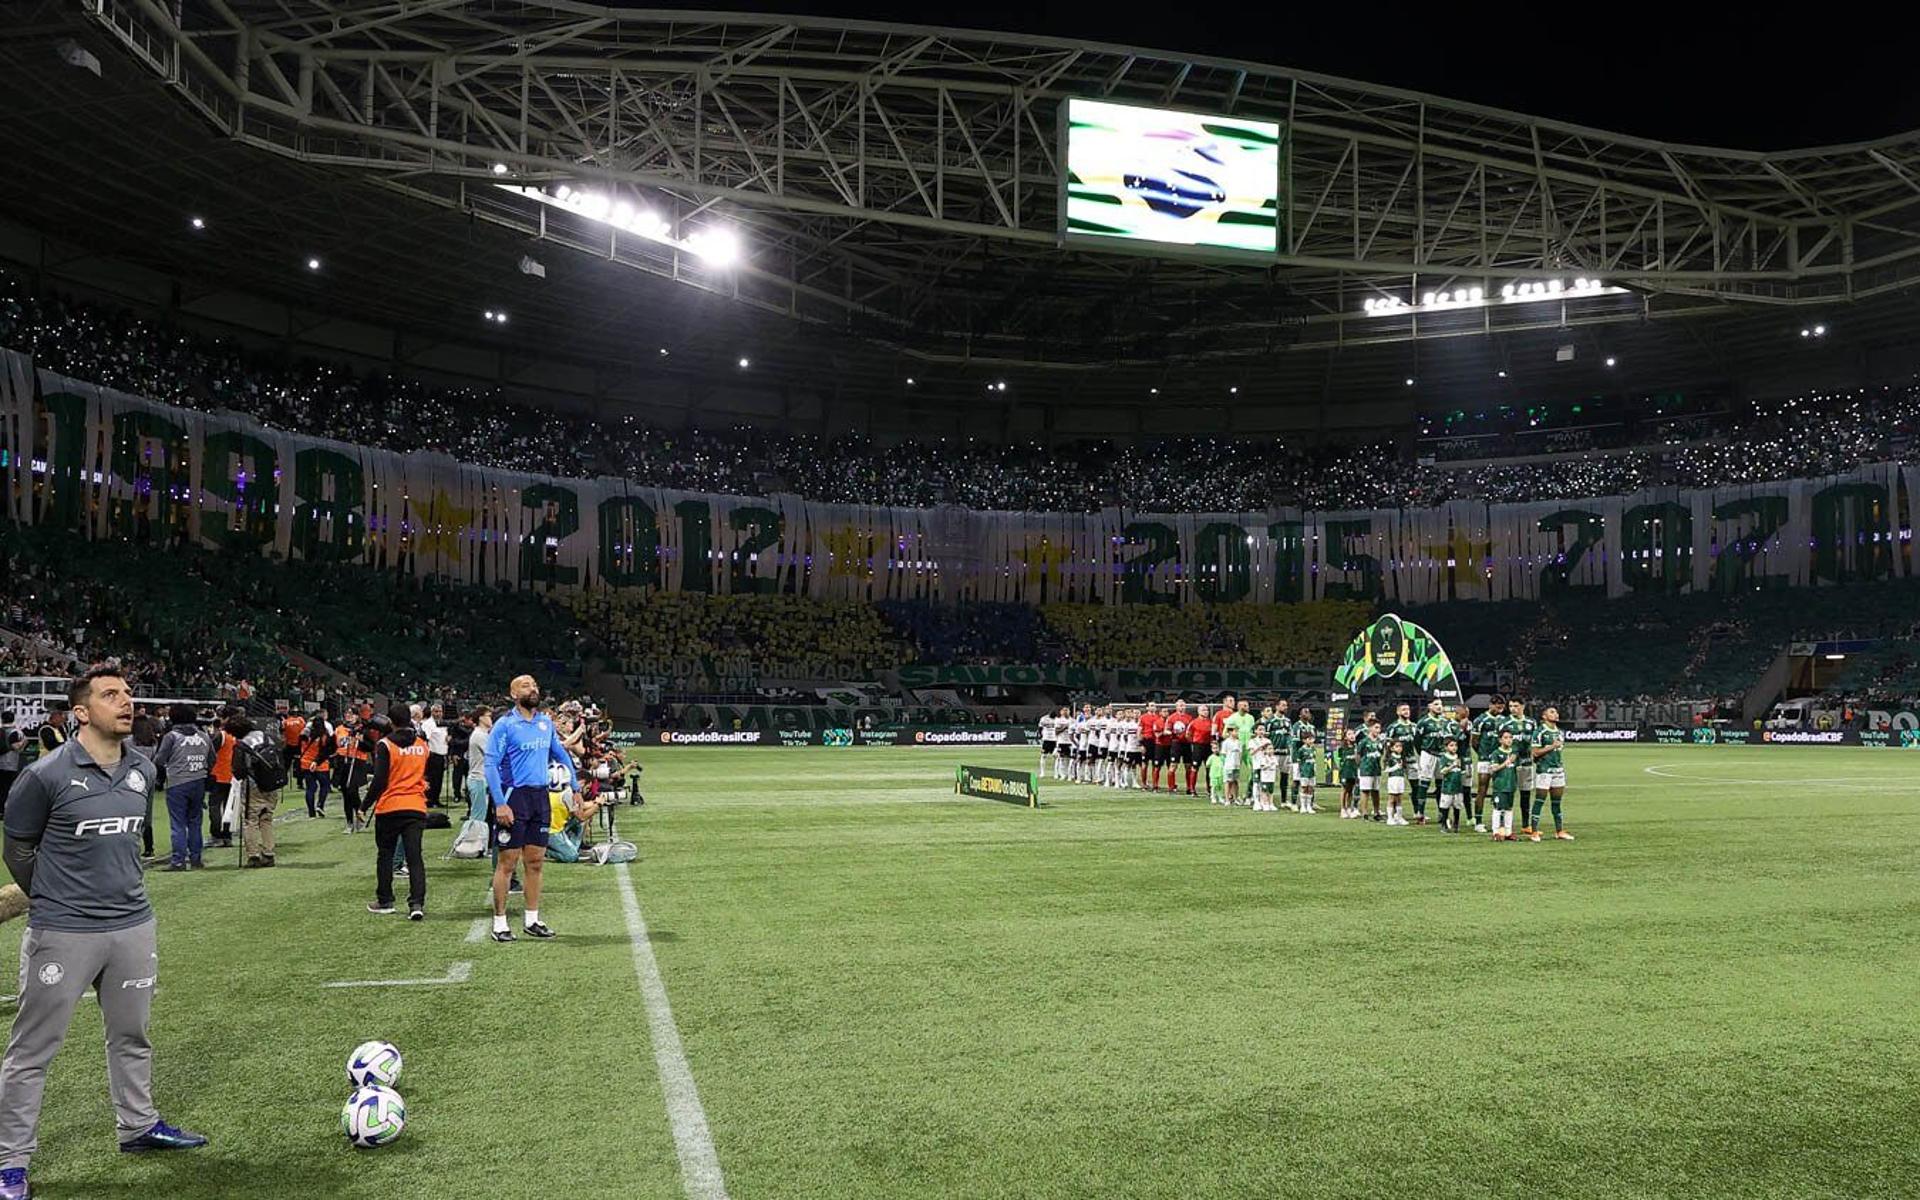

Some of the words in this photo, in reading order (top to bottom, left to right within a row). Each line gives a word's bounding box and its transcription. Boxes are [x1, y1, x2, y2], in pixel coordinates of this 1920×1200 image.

[521, 482, 780, 595] 2012
[1538, 482, 1895, 599] 2020
[1121, 519, 1381, 603] 2015
[660, 731, 761, 744] @CopadoBrasilCBF
[779, 730, 813, 739] YouTube
[860, 730, 898, 740] Instagram
[915, 731, 1008, 744] @CopadoBrasilCBF
[1654, 729, 1686, 737] YouTube
[1763, 732, 1844, 743] @CopadoBrasilCBF
[1859, 732, 1890, 740] YouTube
